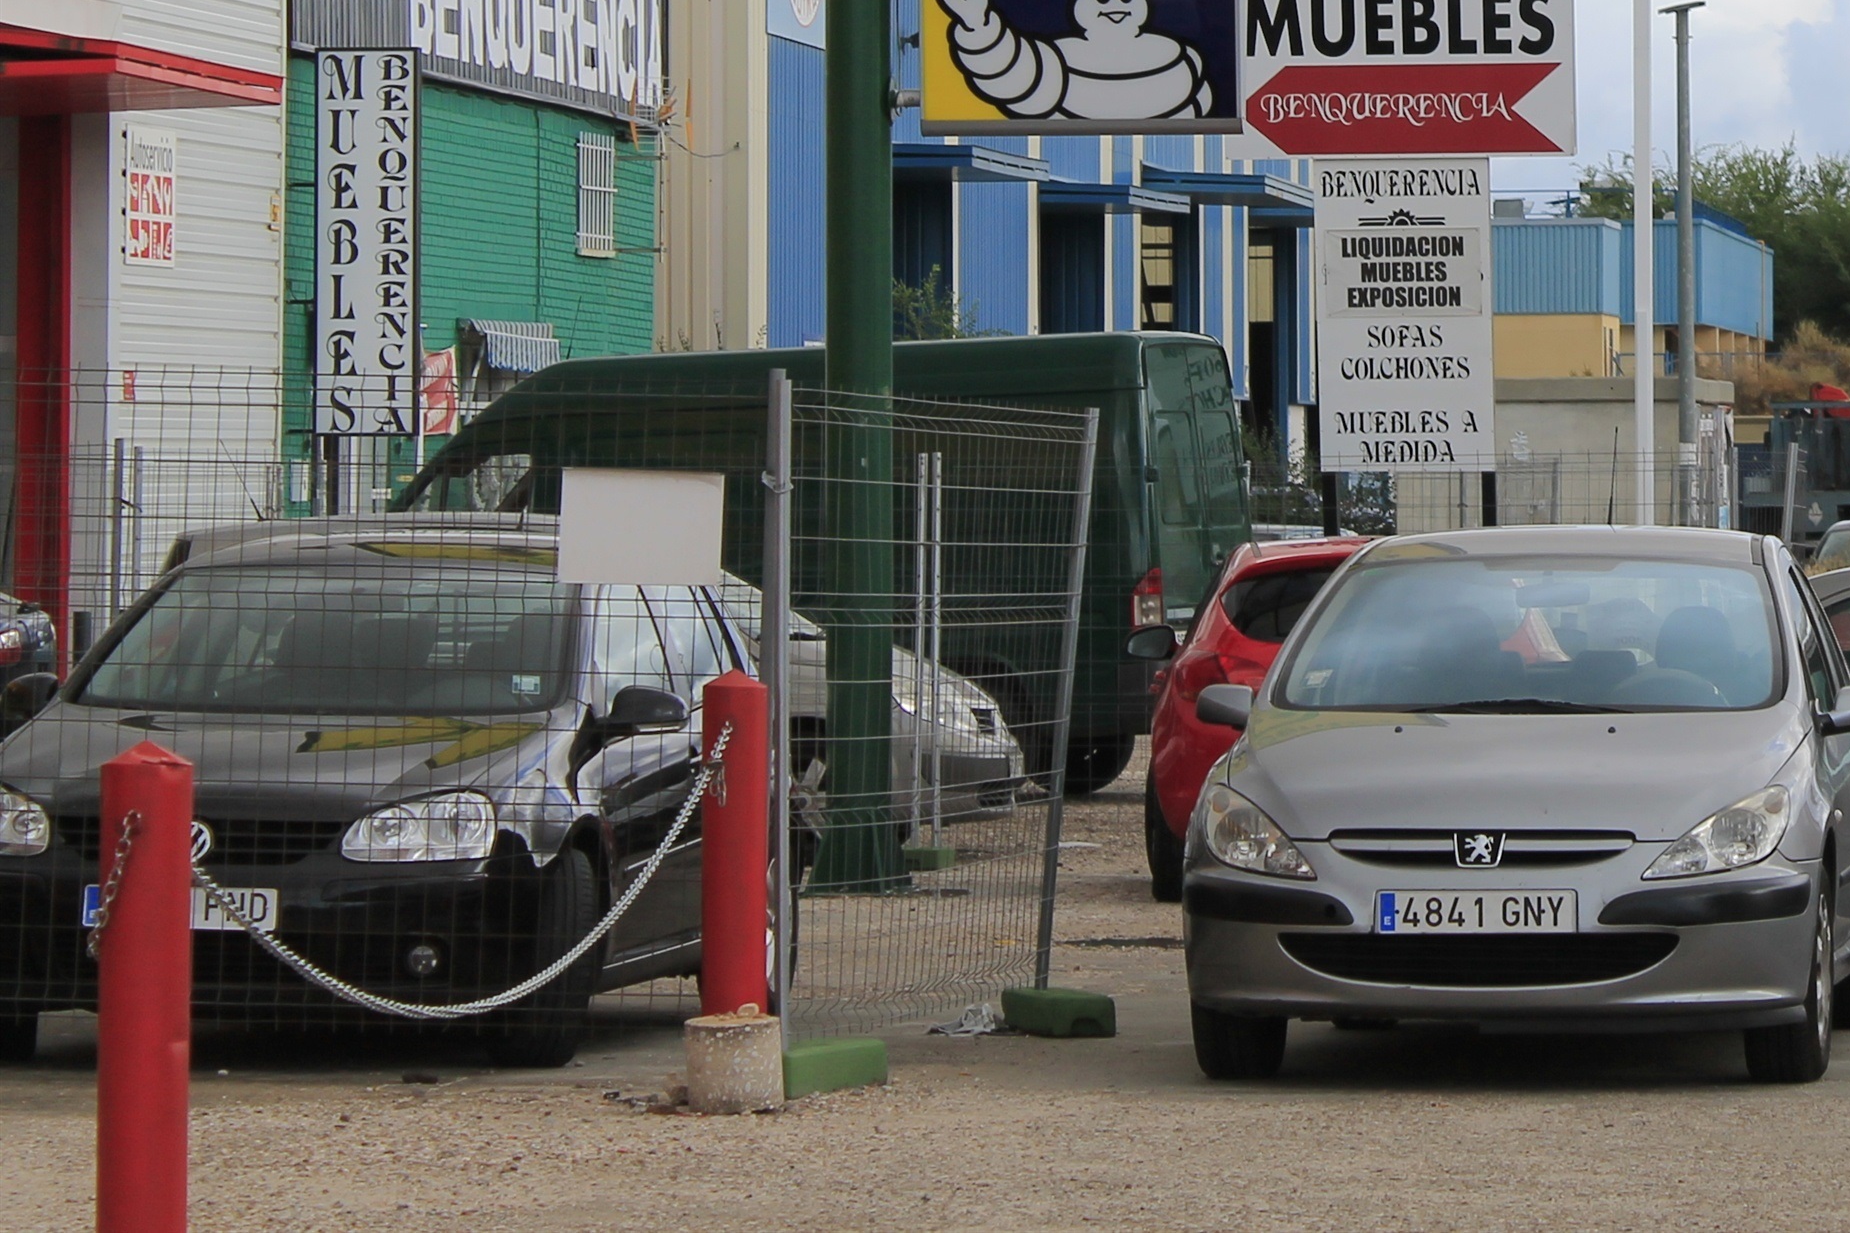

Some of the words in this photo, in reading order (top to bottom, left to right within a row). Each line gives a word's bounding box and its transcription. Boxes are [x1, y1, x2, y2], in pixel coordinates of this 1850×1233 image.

[1260, 92, 1512, 126] BENQUERENCIA
[130, 132, 173, 173] Autoservicio
[1320, 169, 1481, 204] BENQUERENCIA
[323, 54, 366, 433] MUEBLES
[376, 54, 411, 433] BENQUERENCIA
[1341, 236, 1464, 260] LIQUIDACION
[1361, 261, 1447, 283] MUEBLES
[1347, 286, 1462, 308] EXPOSICION
[1367, 325, 1443, 348] SOFAS
[1341, 356, 1470, 380] COLCHONES
[1335, 410, 1449, 434] MUEBLES
[1462, 410, 1479, 433] A
[1359, 440, 1455, 463] MEDIDA
[1402, 897, 1483, 927] 4841
[1502, 896, 1564, 927] GNY
